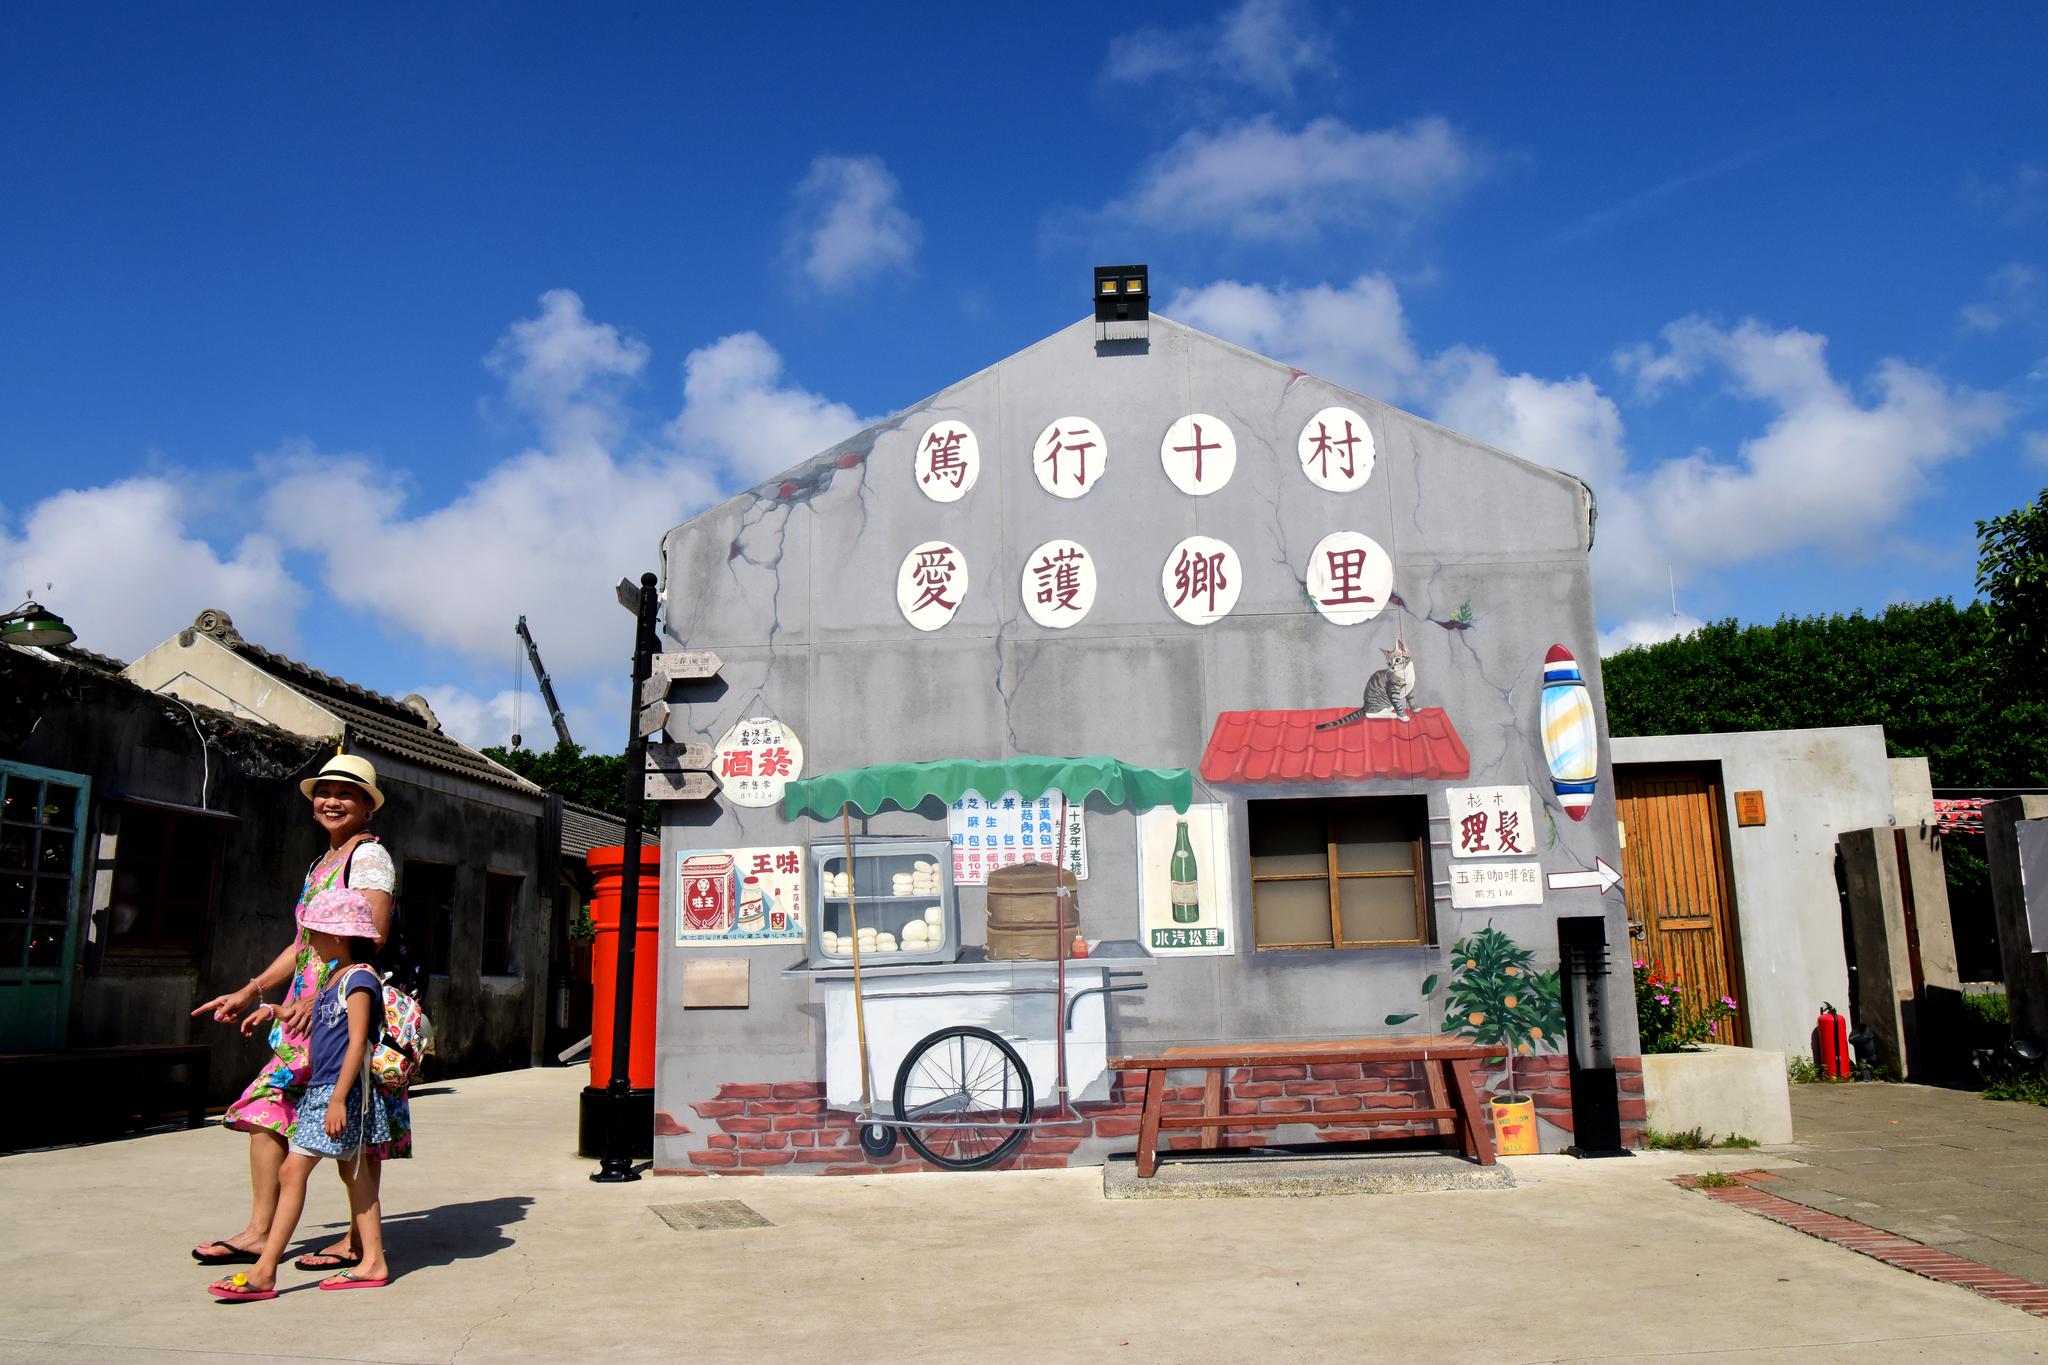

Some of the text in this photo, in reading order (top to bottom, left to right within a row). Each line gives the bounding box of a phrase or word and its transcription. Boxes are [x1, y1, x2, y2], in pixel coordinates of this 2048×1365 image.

[922, 420, 1361, 488] 篤行十村
[911, 547, 1375, 614] 愛護鄉里
[1461, 810, 1522, 853] 理髮
